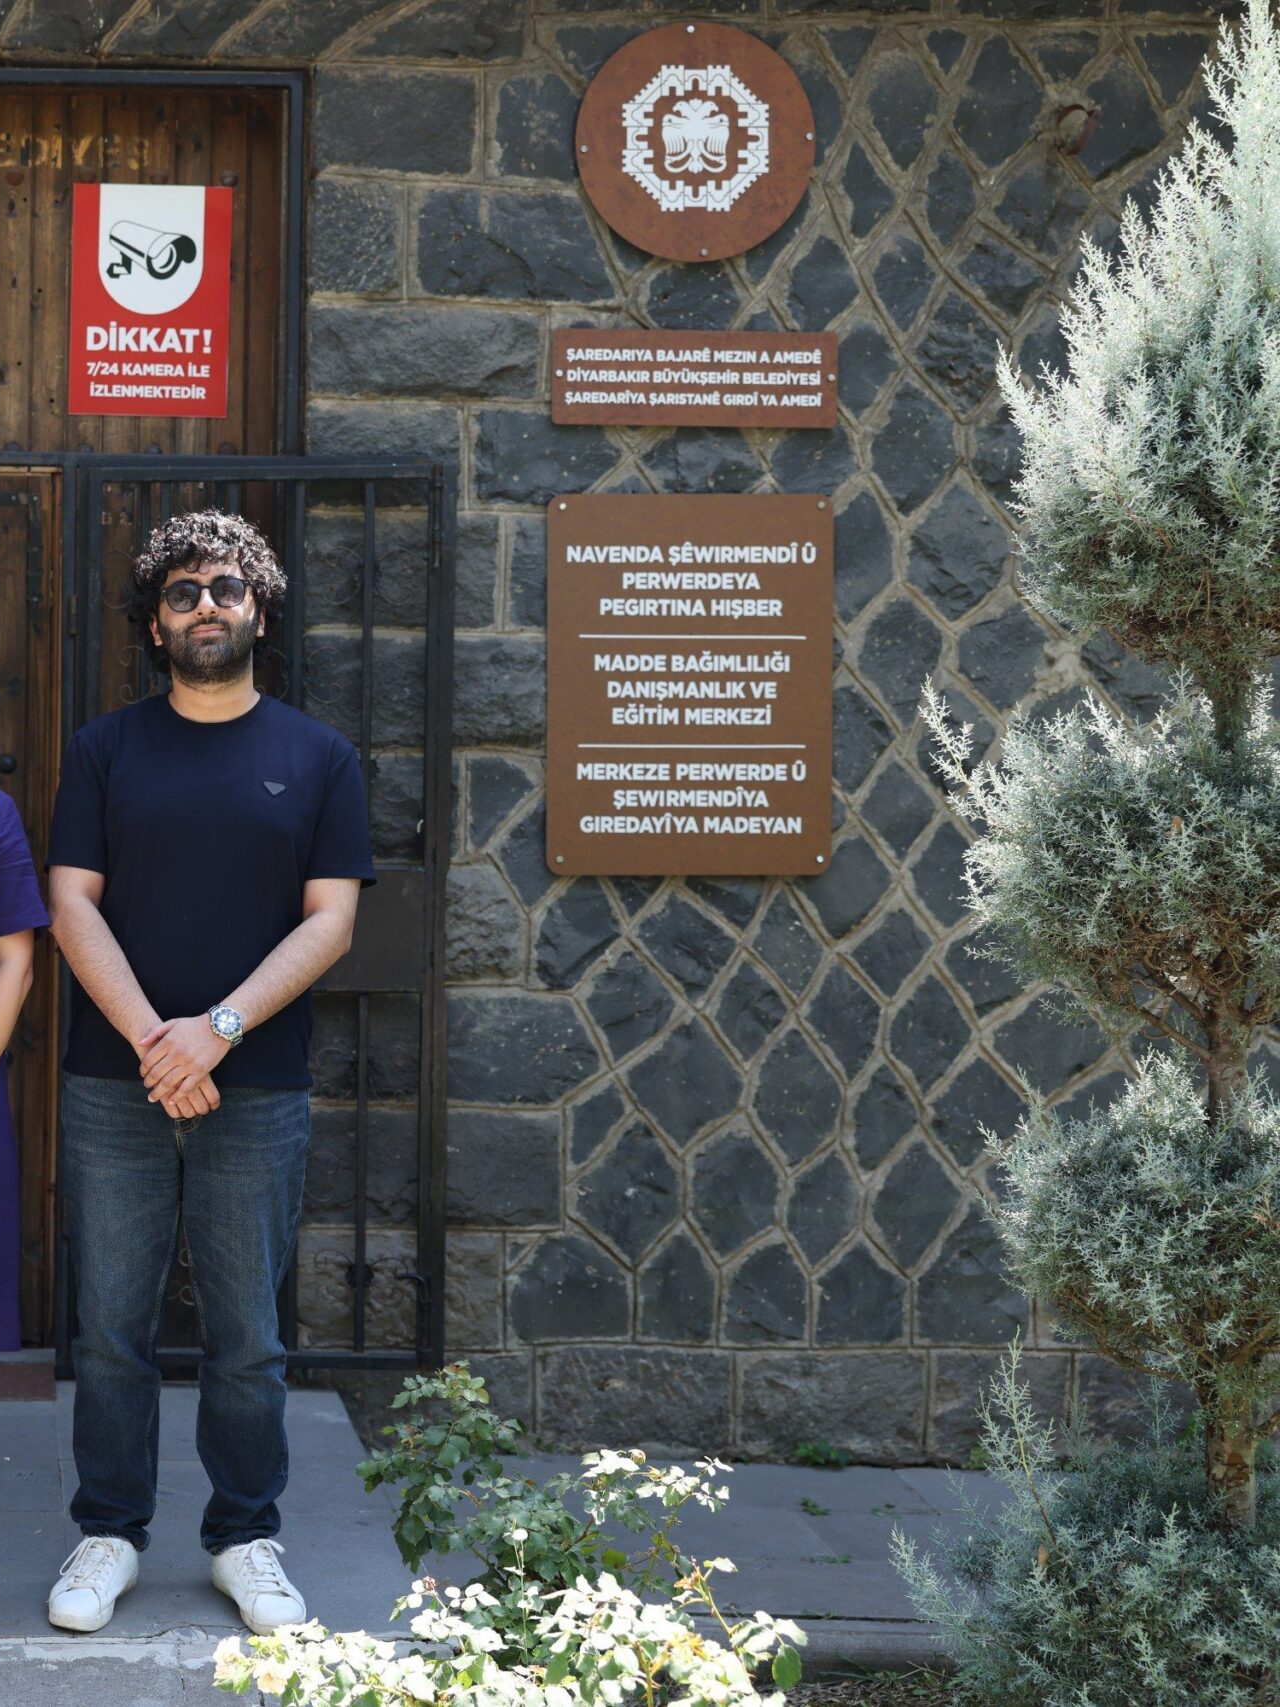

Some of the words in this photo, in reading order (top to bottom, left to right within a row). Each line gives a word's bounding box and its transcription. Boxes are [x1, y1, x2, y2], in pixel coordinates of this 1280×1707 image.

[86, 321, 212, 354] DİKKAT!
[566, 348, 653, 362] ŞAREDARIYA
[656, 347, 711, 363] BAJARÊ
[713, 350, 757, 363] MEZIN
[760, 351, 770, 363] A
[773, 349, 822, 364] AMEDÊ
[86, 361, 120, 377] 7/24
[121, 362, 185, 378] KAMERA
[187, 361, 210, 378] İLE
[566, 367, 649, 383] DİYARBAKIR
[653, 368, 739, 385] BÜYÜKŞEHİR
[742, 370, 821, 385] BELEDİYESİ
[89, 380, 207, 400] İZLENMEKTEDİR
[648, 391, 721, 406] ŞARISTANÊ
[760, 395, 777, 407] YA
[566, 545, 664, 563] NAVENDA
[668, 541, 798, 567] ŞÊWIRMENDÎ
[801, 541, 817, 563] Û
[622, 572, 760, 590] PERWERDEYA
[599, 598, 707, 617] PEGIRTINA
[710, 599, 783, 619] HIŞBER
[593, 654, 666, 673] MADDE
[671, 650, 790, 673] BAĞIMLILIĞI
[606, 681, 745, 702] DANIŞMANLIK
[750, 681, 777, 699] VE
[611, 703, 680, 726] EĞİTİM
[684, 704, 772, 725] MERKEZİ
[576, 763, 670, 781] MERKEZE
[676, 763, 787, 781] PERWERDE
[791, 759, 807, 781] Û
[613, 786, 769, 810] ŞEWIRMENDÎYA
[702, 815, 803, 834] MADEYAN
